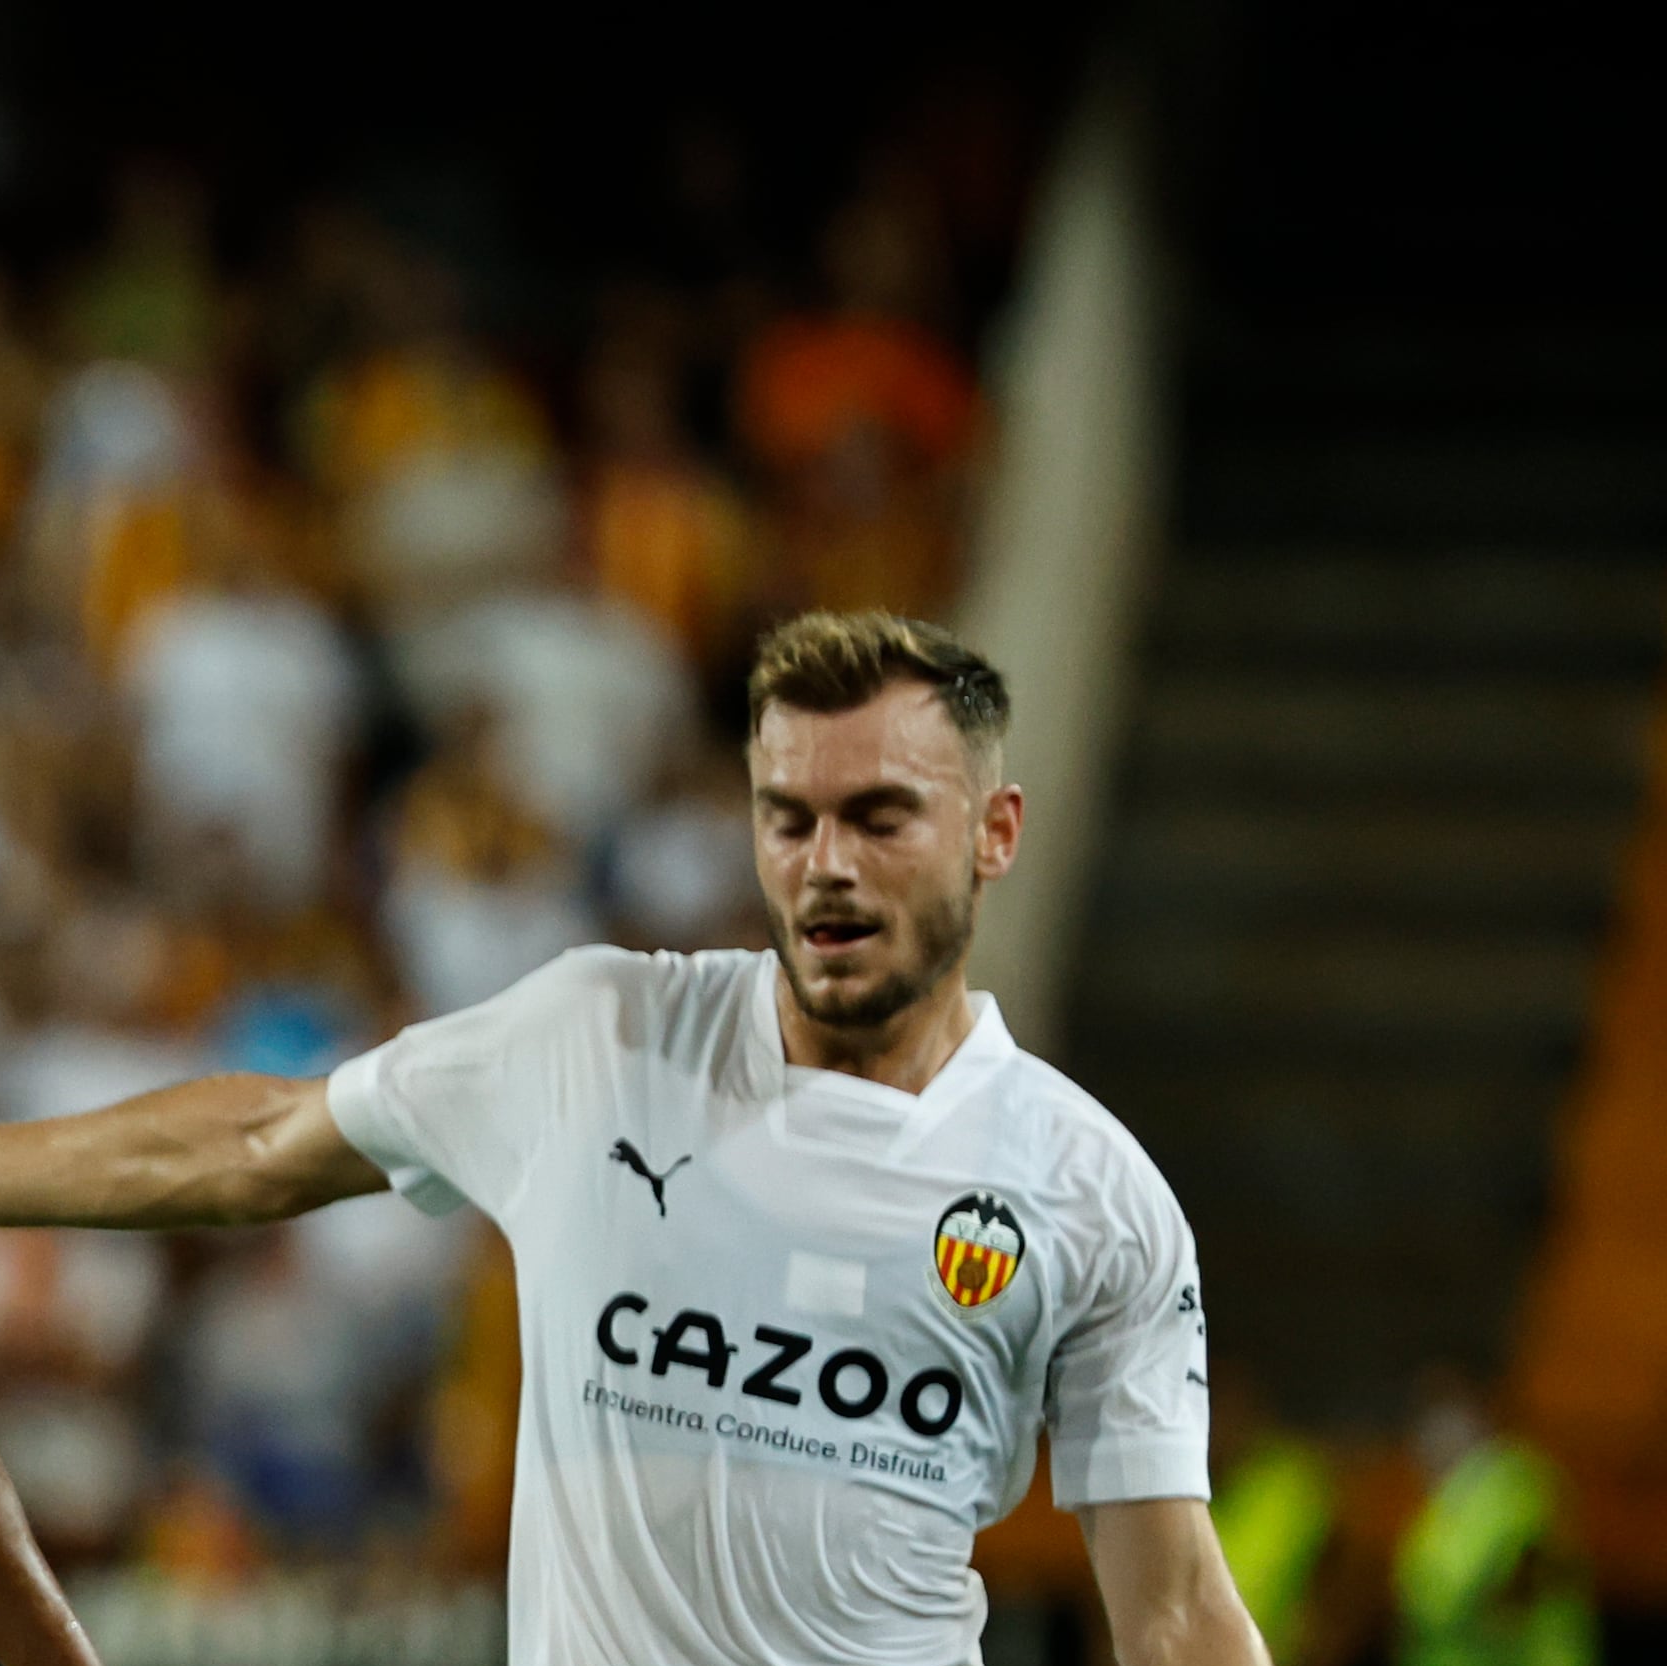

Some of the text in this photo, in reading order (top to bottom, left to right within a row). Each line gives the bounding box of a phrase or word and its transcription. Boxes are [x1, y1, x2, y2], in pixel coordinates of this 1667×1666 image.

[596, 1291, 964, 1437] CAZOO
[715, 1412, 842, 1462] Conduce.
[849, 1440, 949, 1484] Disfruta.
